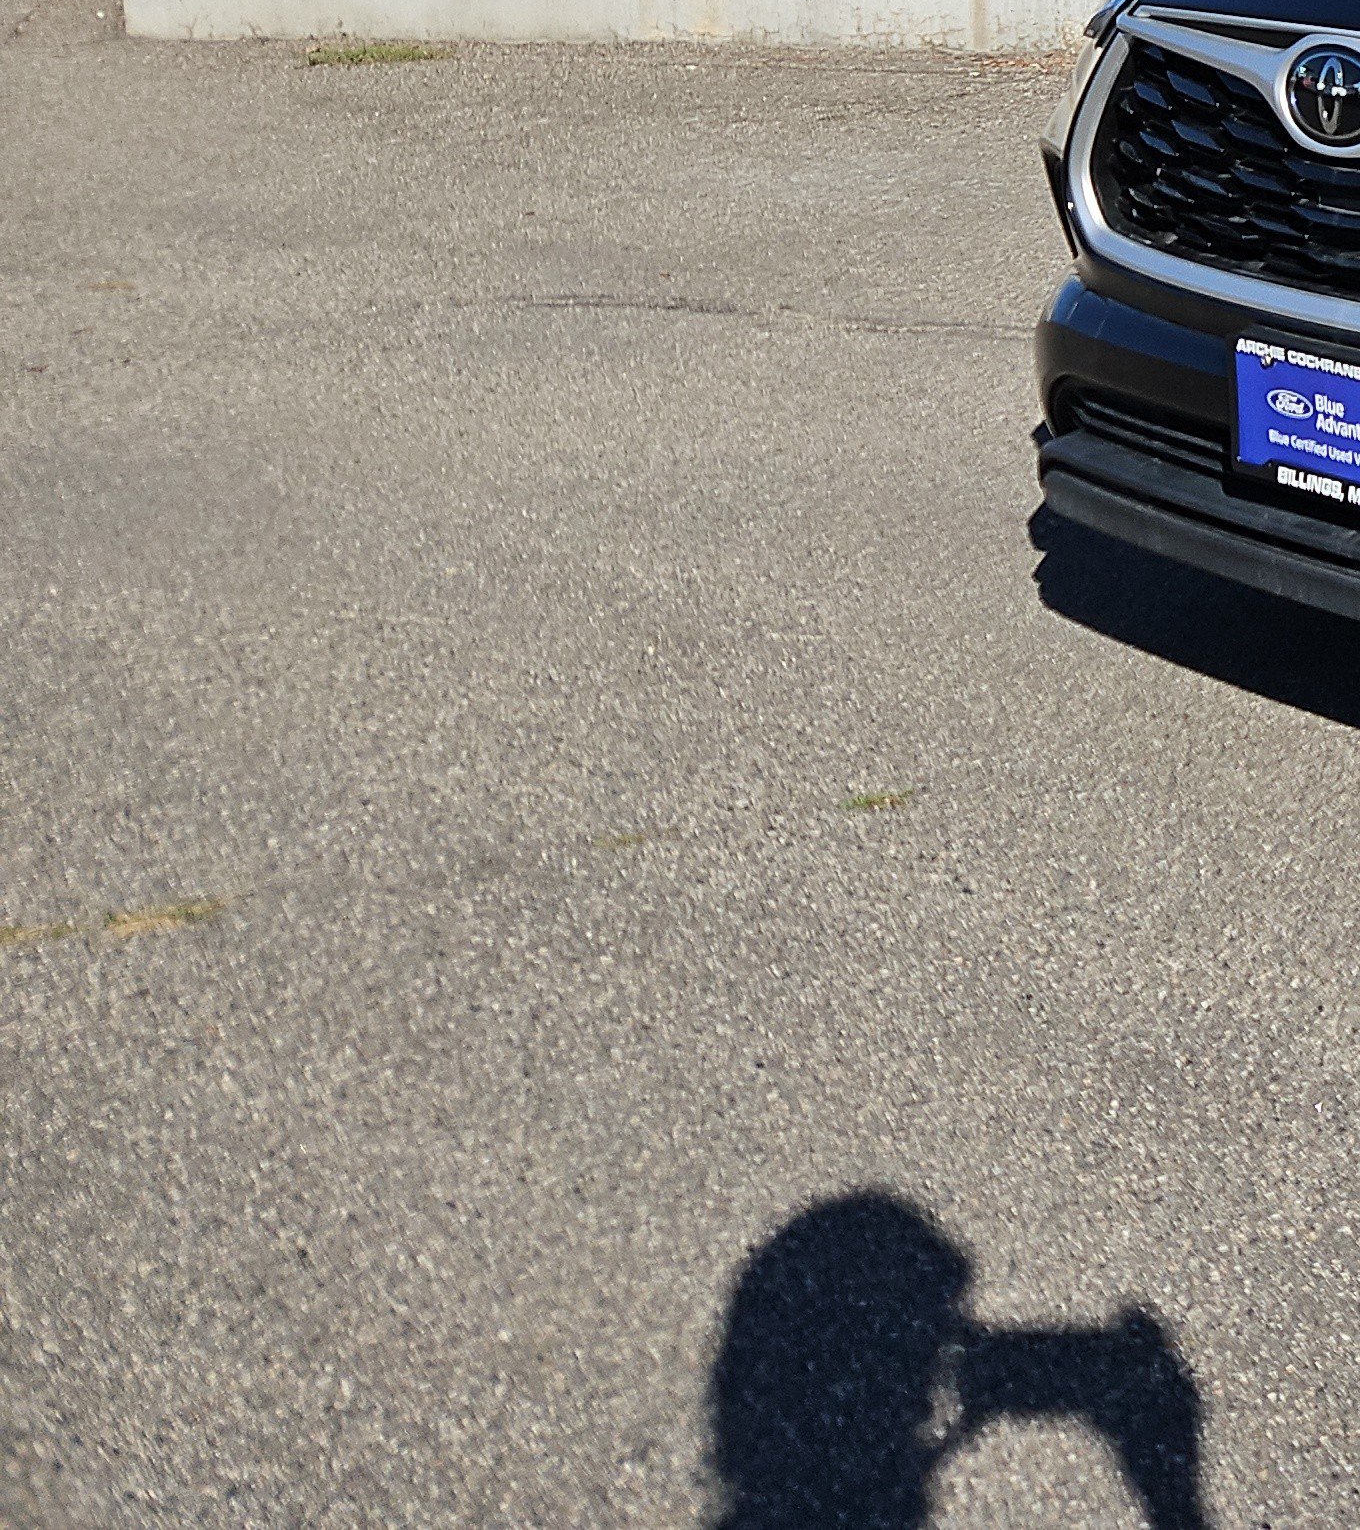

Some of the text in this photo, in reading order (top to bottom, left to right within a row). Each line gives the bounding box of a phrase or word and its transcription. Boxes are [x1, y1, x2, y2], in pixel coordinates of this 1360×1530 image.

[1236, 338, 1286, 361] ARCHIE
[1314, 393, 1345, 418] Blue
[1268, 428, 1290, 447] Blue
[1290, 434, 1328, 458] Certified
[1328, 445, 1353, 464] Used
